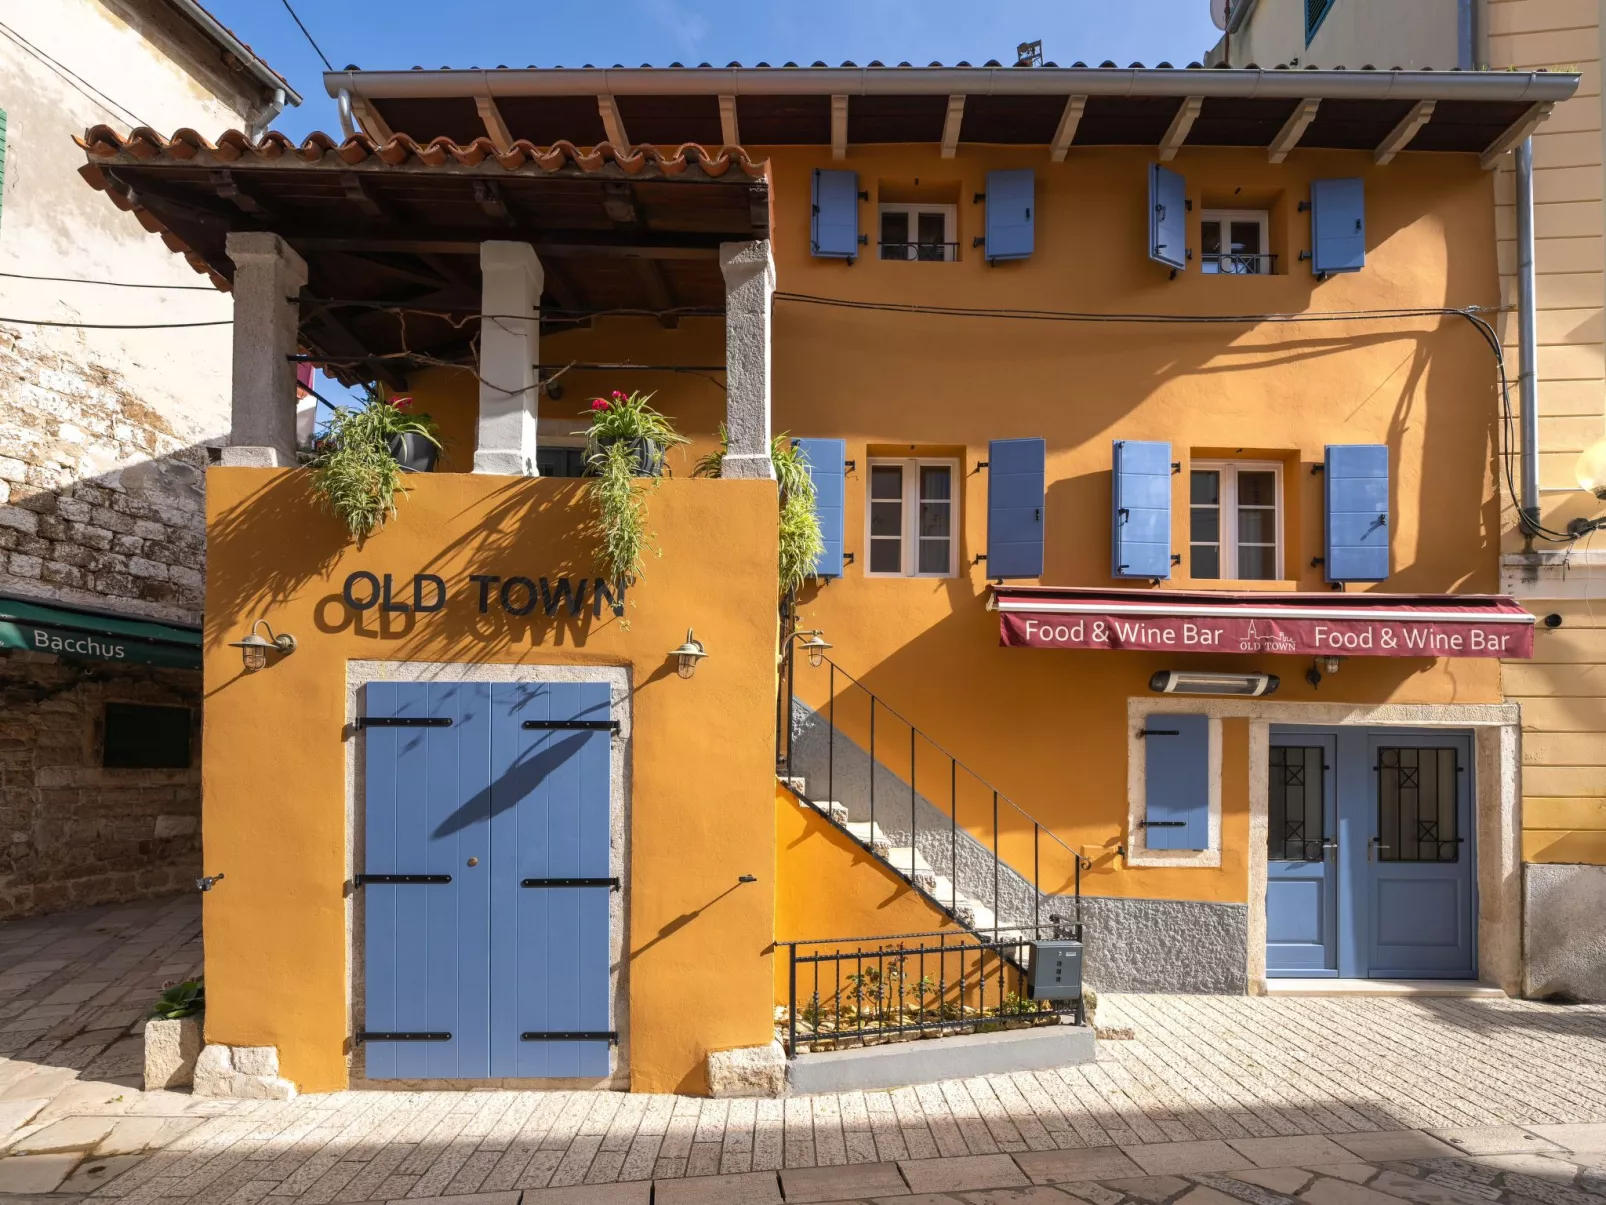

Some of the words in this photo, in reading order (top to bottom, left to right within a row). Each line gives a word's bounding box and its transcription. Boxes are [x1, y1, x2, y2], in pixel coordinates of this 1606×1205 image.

[343, 570, 447, 613] OLD
[469, 574, 625, 617] TOWN
[34, 629, 125, 658] Bacchus
[1025, 620, 1084, 641] Food
[1092, 622, 1109, 642] &
[1115, 622, 1176, 643] Wine
[1183, 624, 1224, 645] Bar
[1315, 627, 1372, 648] Food
[1380, 628, 1398, 648] &
[1403, 629, 1463, 649] Wine
[1471, 630, 1510, 650] Bar
[1240, 642, 1260, 650] OLD
[1265, 642, 1296, 651] TOWN
